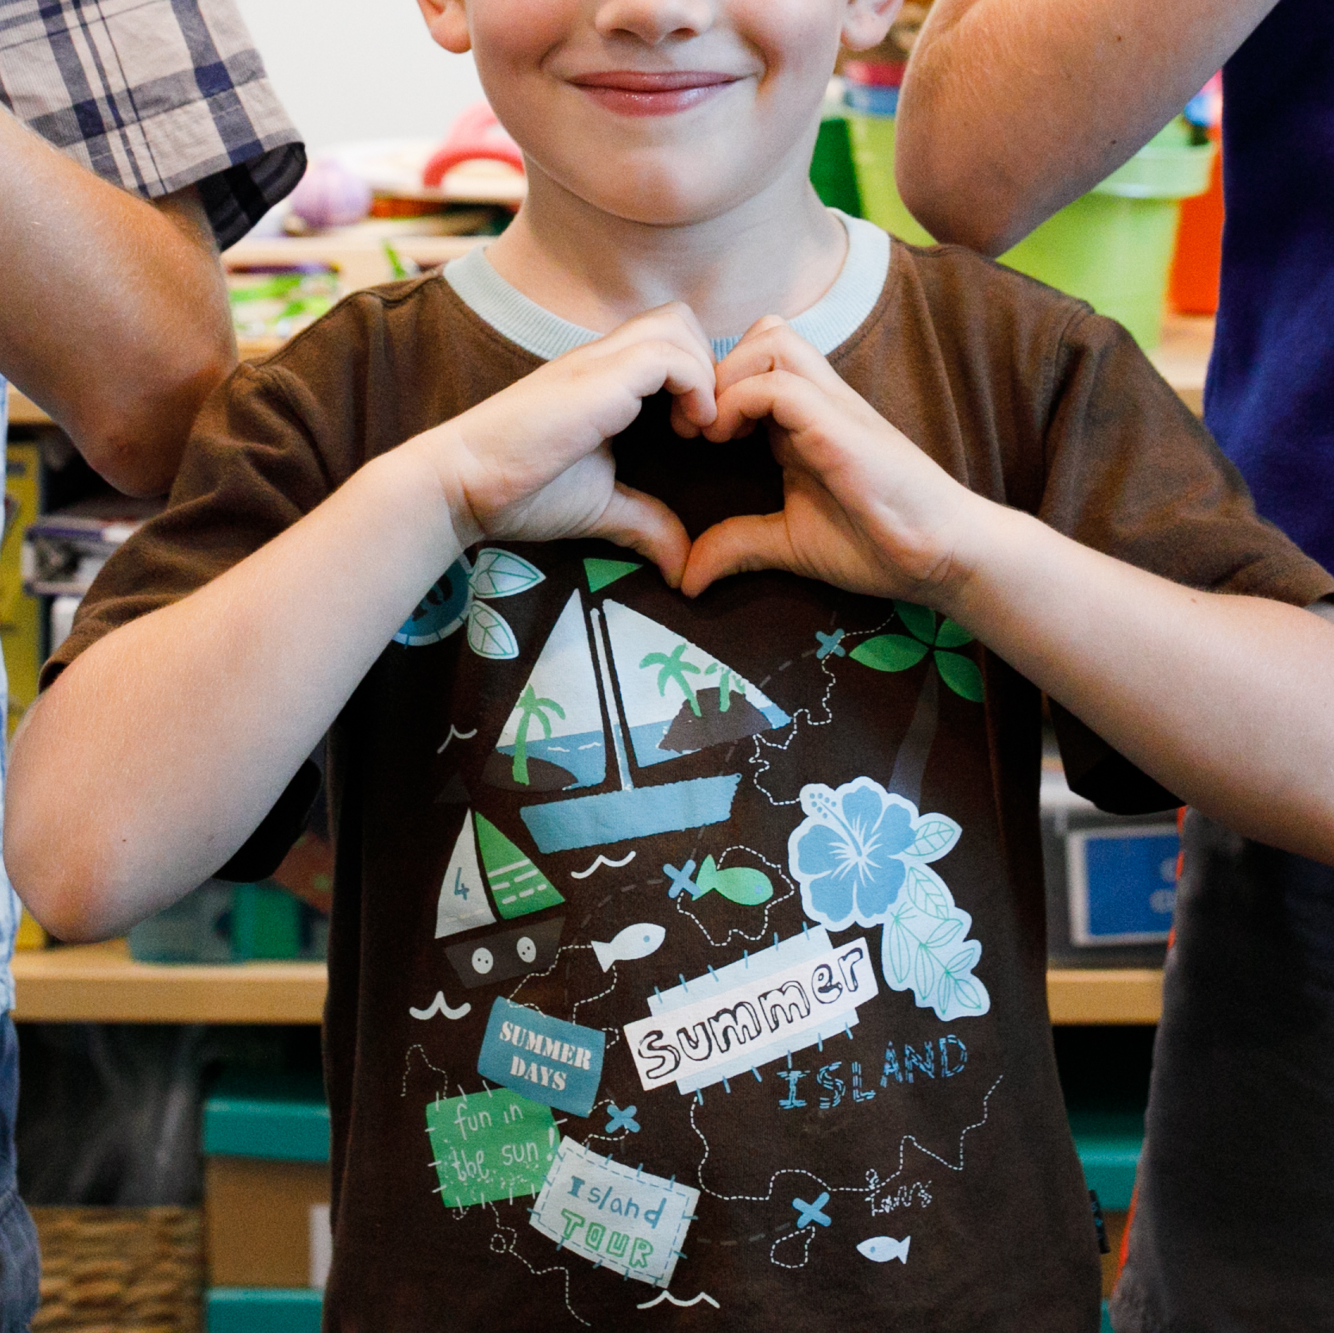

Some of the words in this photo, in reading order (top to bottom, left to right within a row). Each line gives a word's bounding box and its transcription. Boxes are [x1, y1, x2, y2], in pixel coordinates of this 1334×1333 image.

[453, 866, 471, 901] 4
[637, 946, 865, 1080] Summer
[499, 1020, 592, 1072] SUMMER
[776, 1033, 969, 1110] ISLAND
[509, 1055, 568, 1092] DAYS
[453, 1103, 493, 1140] fun
[503, 1101, 524, 1124] in
[451, 1147, 490, 1181] the
[566, 1174, 668, 1229] Island
[560, 1208, 655, 1269] TOUR
